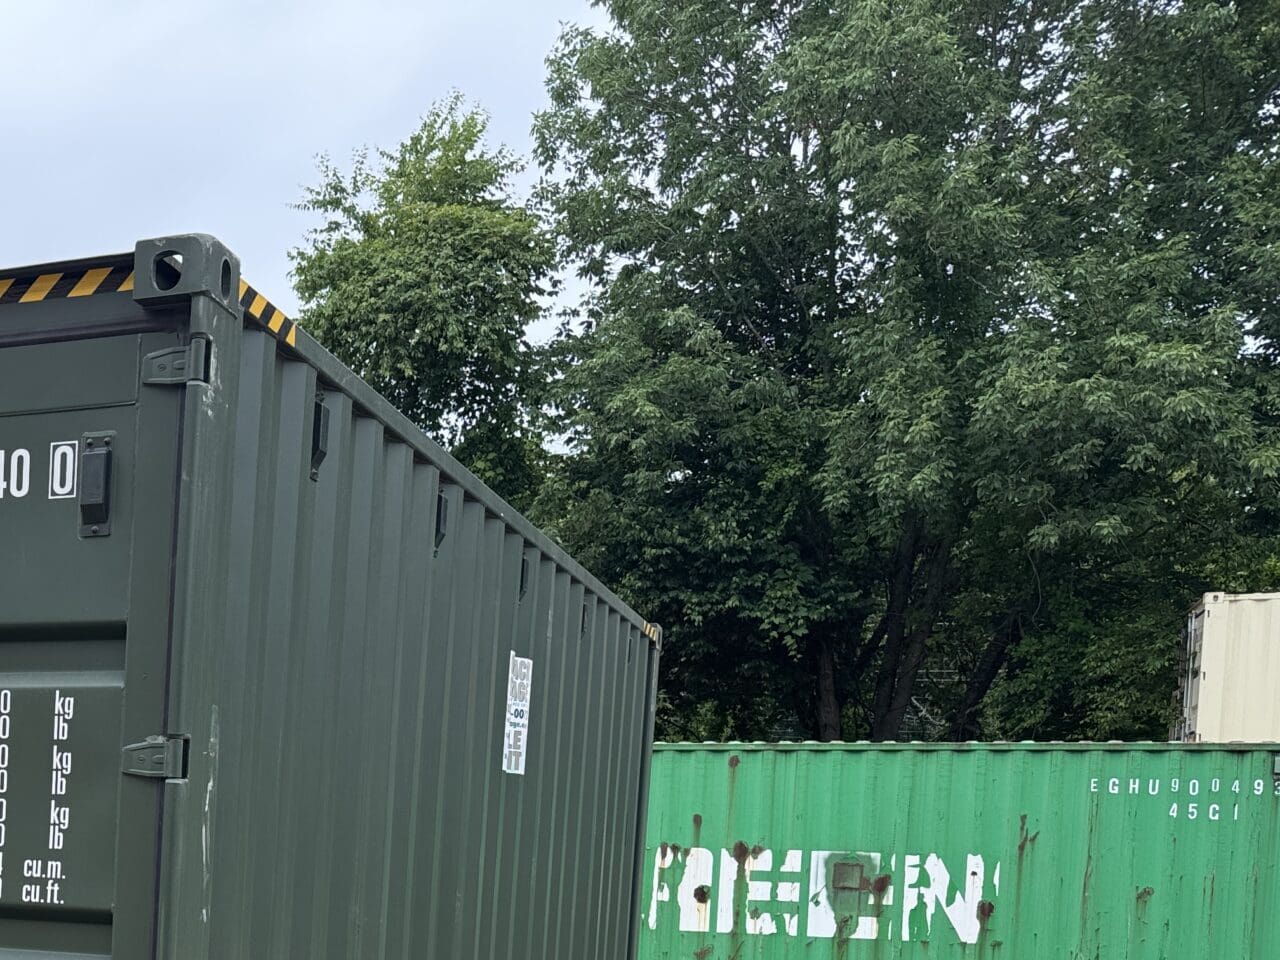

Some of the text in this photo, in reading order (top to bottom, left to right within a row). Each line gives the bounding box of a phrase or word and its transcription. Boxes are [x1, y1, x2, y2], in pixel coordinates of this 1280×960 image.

[52, 445, 75, 495] 0
[55, 690, 74, 719] kg
[54, 716, 68, 741] lb
[53, 745, 72, 775] kg
[51, 770, 66, 795] lb
[50, 800, 69, 830] kg
[48, 825, 64, 850] lb
[23, 859, 66, 880] cu.m.
[22, 882, 65, 905] cu.ft.
